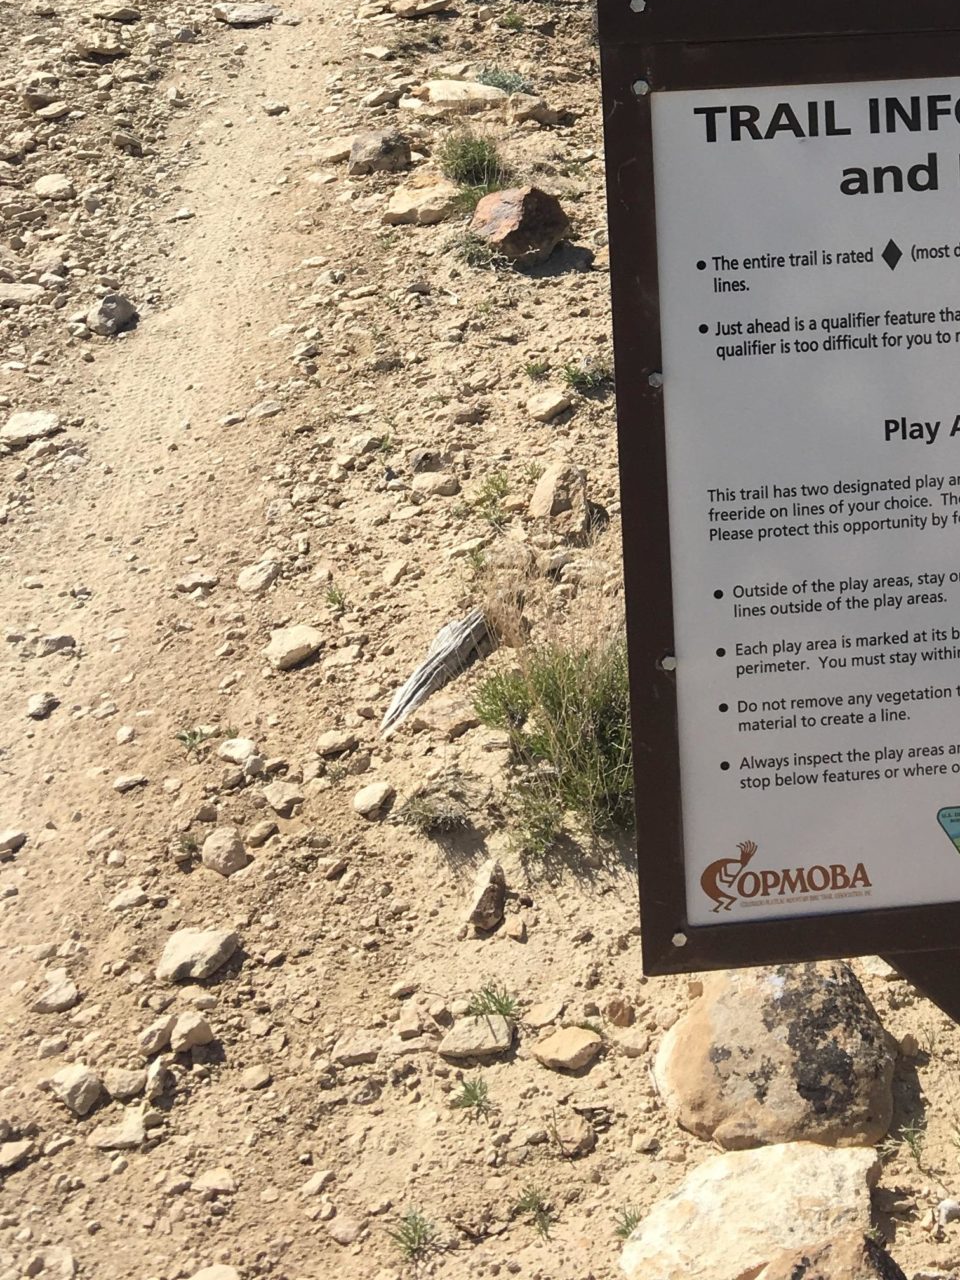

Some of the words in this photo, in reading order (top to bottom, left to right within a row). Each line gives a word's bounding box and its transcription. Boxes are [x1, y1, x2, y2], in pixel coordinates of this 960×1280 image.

[692, 99, 852, 143] TRAIL
[839, 151, 939, 196] and
[711, 254, 740, 272] The
[742, 252, 786, 270] entire
[788, 249, 818, 268] trail
[821, 249, 833, 266] is
[836, 246, 874, 265] rated
[910, 243, 951, 263] (most
[884, 416, 942, 446] Play
[733, 603, 767, 618] lines
[769, 598, 823, 616] outside
[826, 595, 843, 612] of
[844, 595, 870, 610] the
[873, 592, 904, 612] play
[906, 592, 948, 606] areas.
